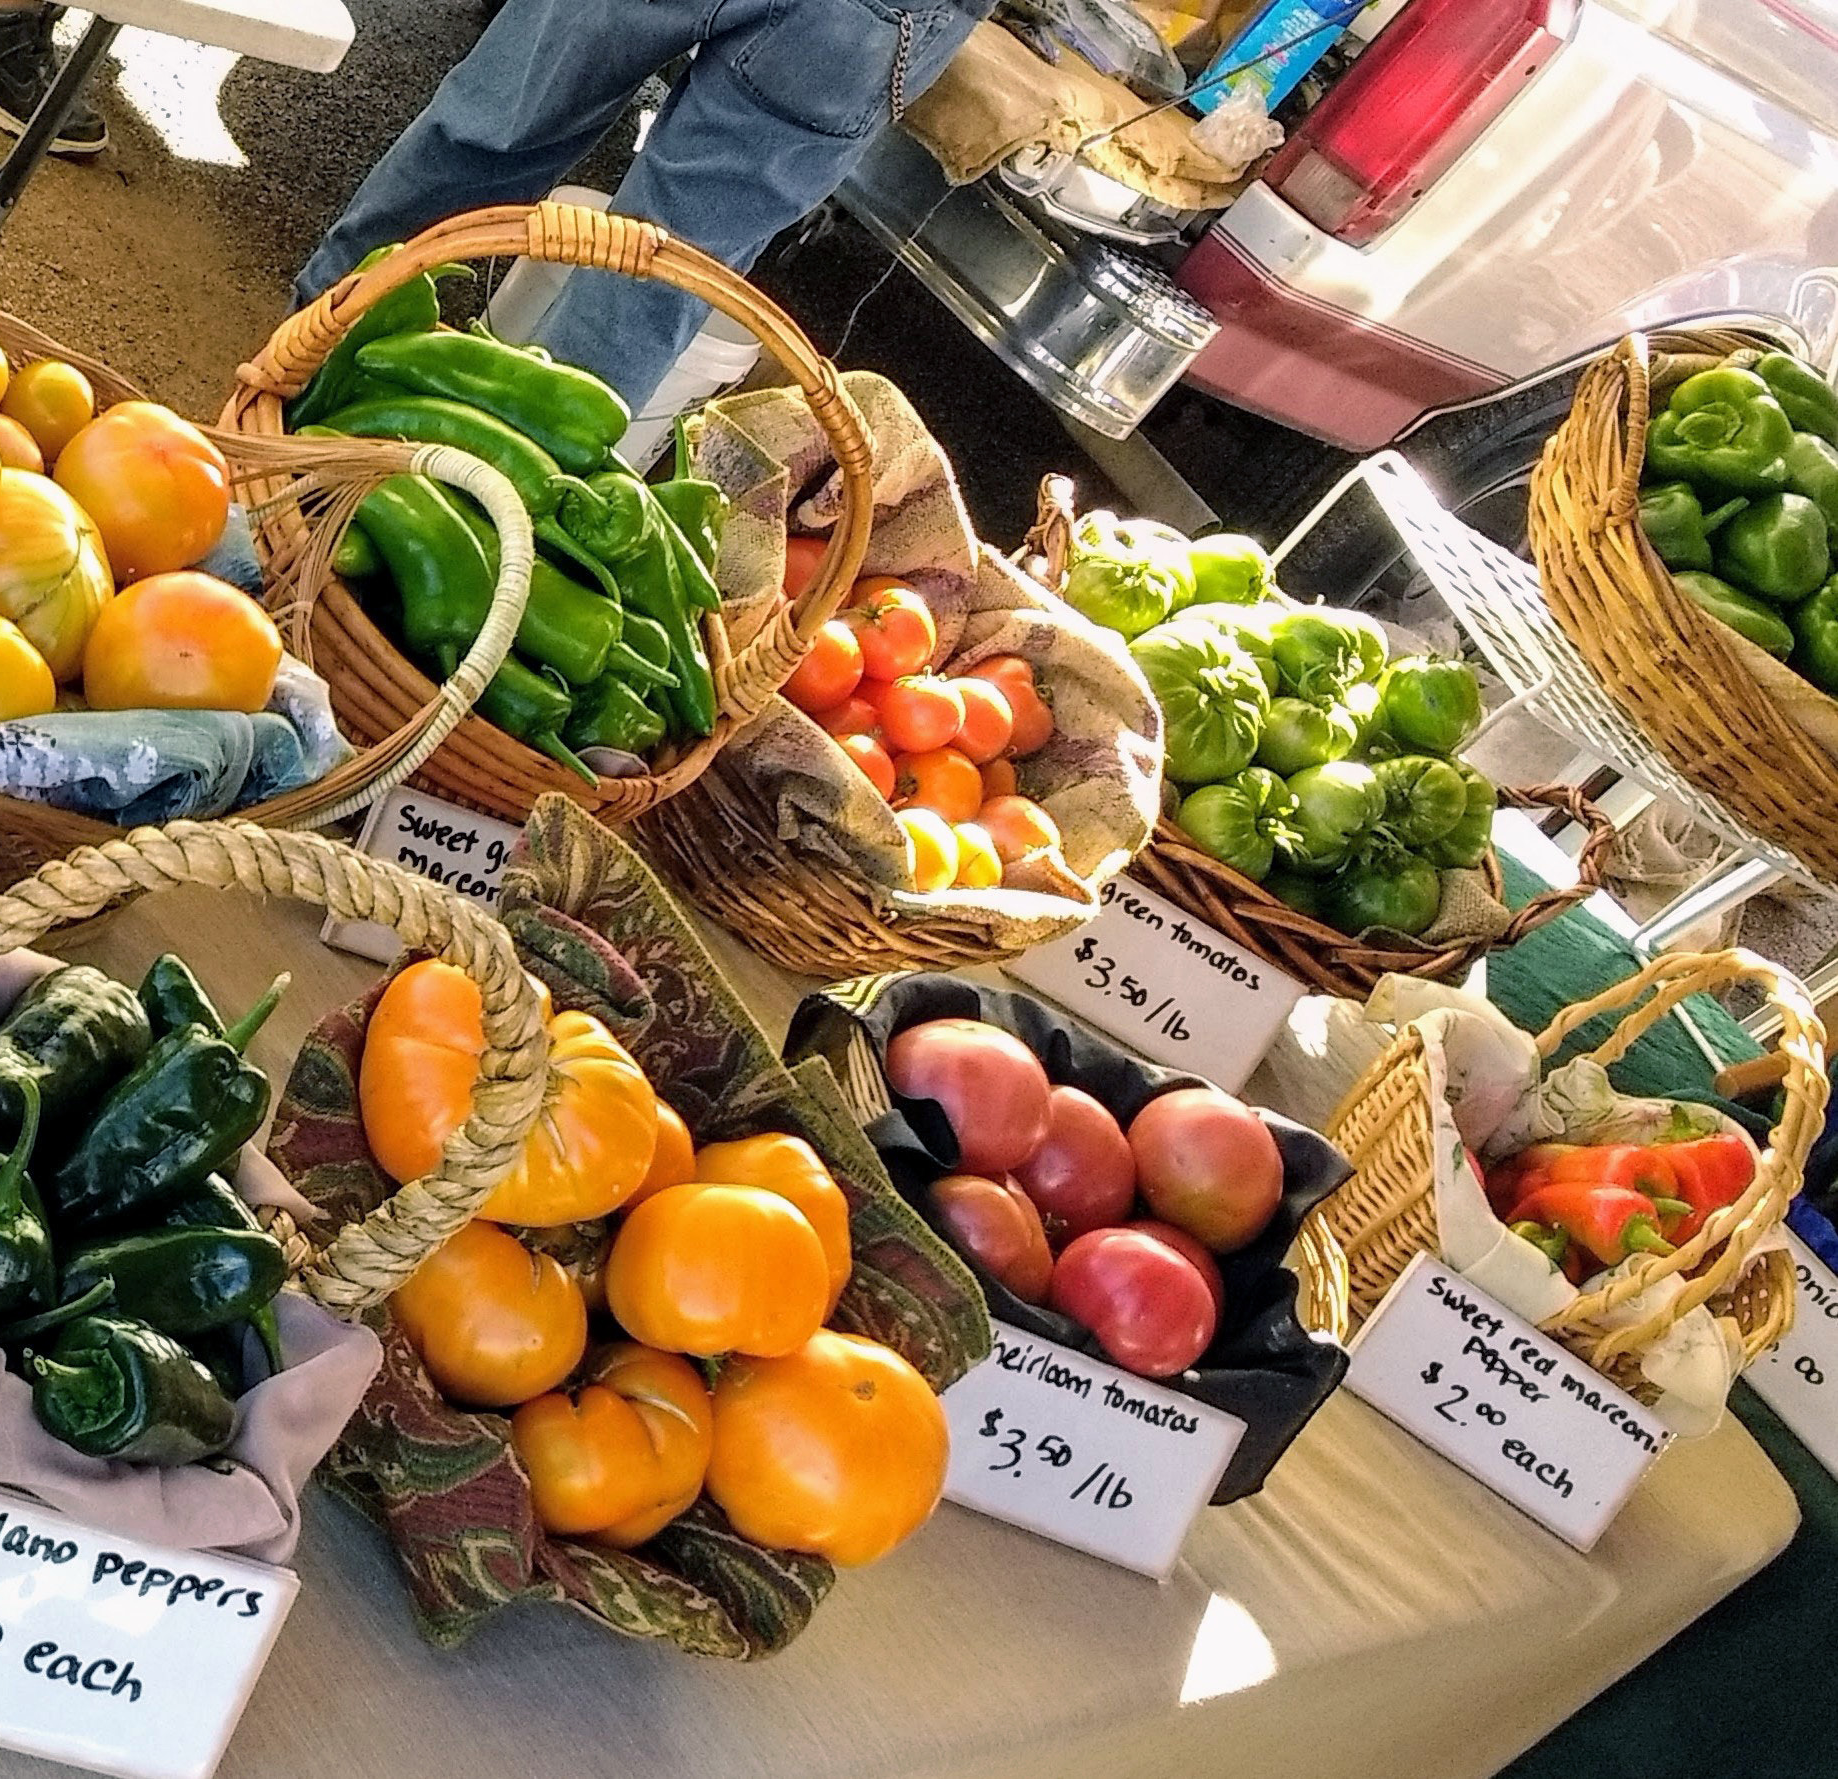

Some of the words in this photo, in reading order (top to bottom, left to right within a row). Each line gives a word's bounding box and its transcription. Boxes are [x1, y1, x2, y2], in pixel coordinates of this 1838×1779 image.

[1100, 882, 1164, 931] green
[1170, 921, 1260, 991] tomatos
[992, 1329, 1093, 1399] heirloom
[1102, 1379, 1199, 1434] tomatos
[1509, 1336, 1558, 1377] red
[1501, 1438, 1574, 1499] each
[93, 1550, 265, 1618] peppers
[23, 1640, 143, 1702] each
